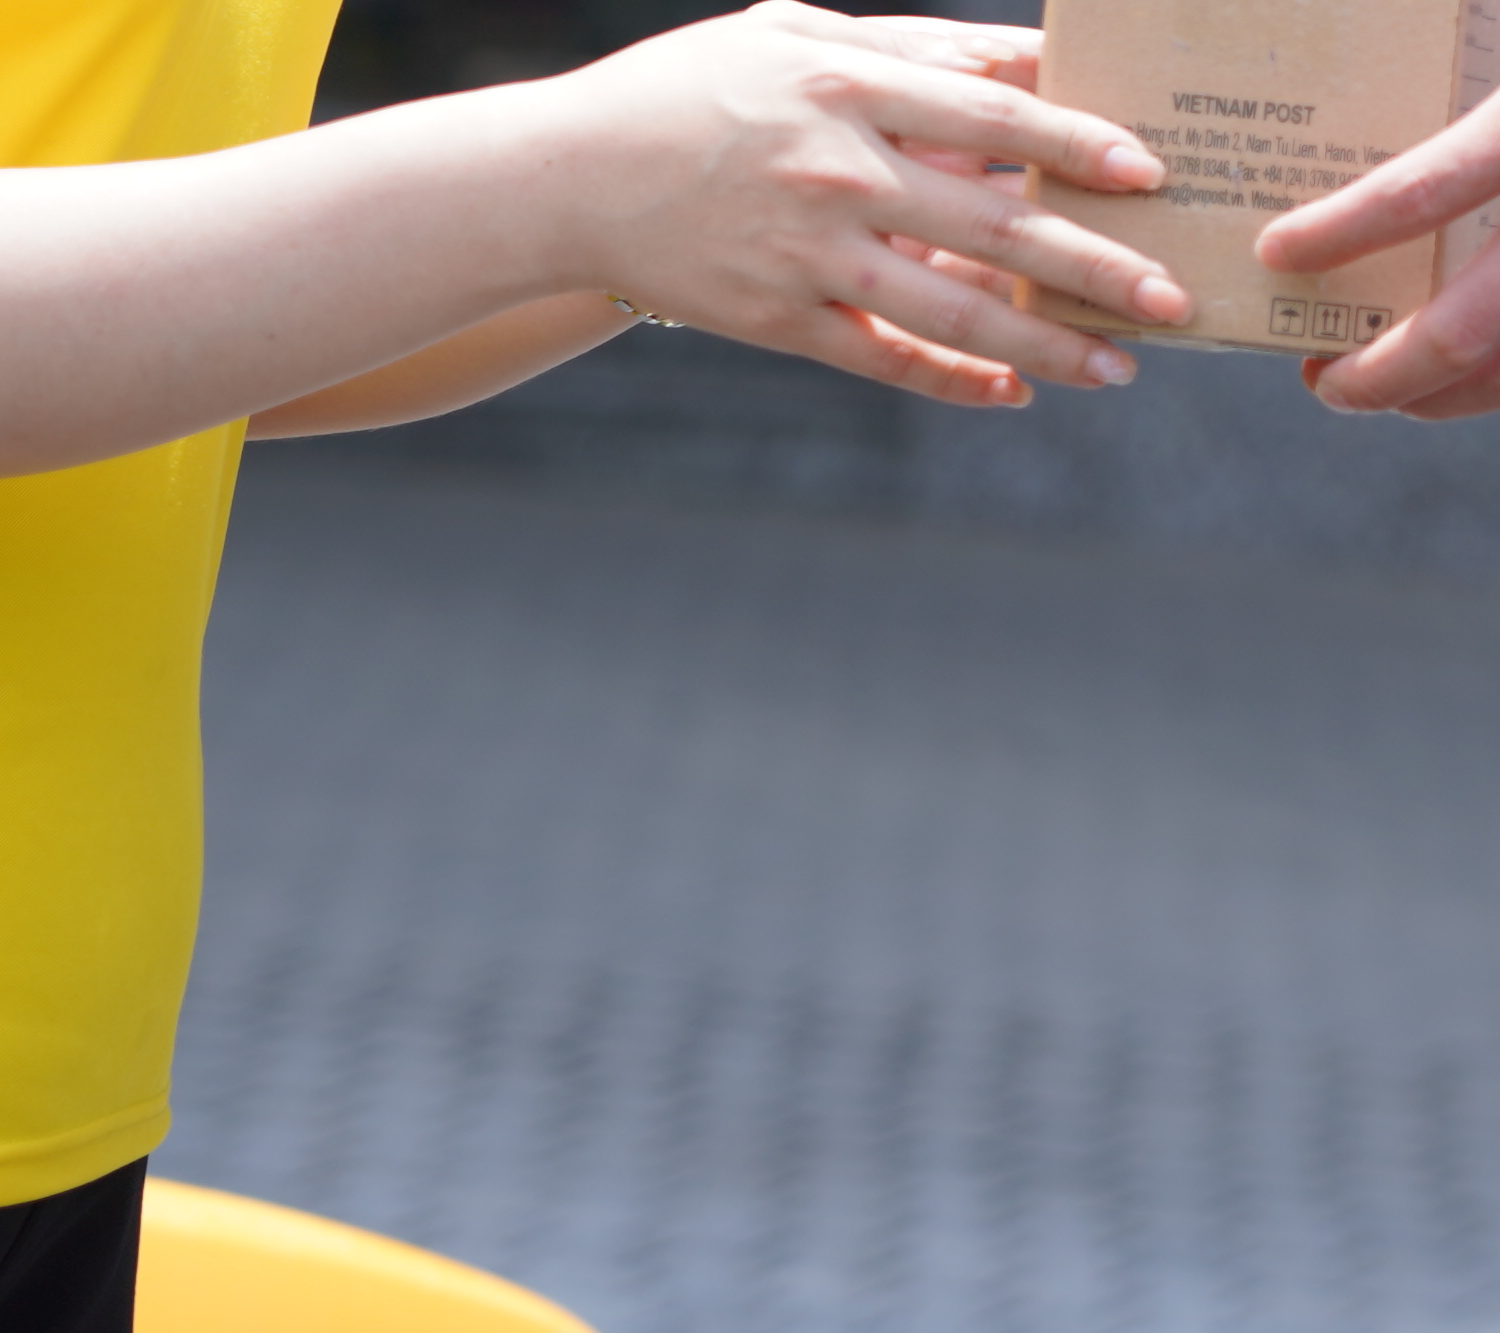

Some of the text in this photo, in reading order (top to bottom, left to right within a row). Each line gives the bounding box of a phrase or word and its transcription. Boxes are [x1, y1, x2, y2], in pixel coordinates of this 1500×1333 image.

[1172, 91, 1316, 126] VIETNAM POST
[1137, 122, 1165, 148] Hung
[1186, 127, 1202, 151] My
[1205, 129, 1230, 150] Dinh
[1246, 133, 1272, 153] Nam
[1276, 136, 1289, 156] Tu
[1174, 155, 1201, 175] 3768
[1263, 164, 1282, 184] +84
[1285, 166, 1307, 191] (24)
[1309, 169, 1336, 190] 3768
